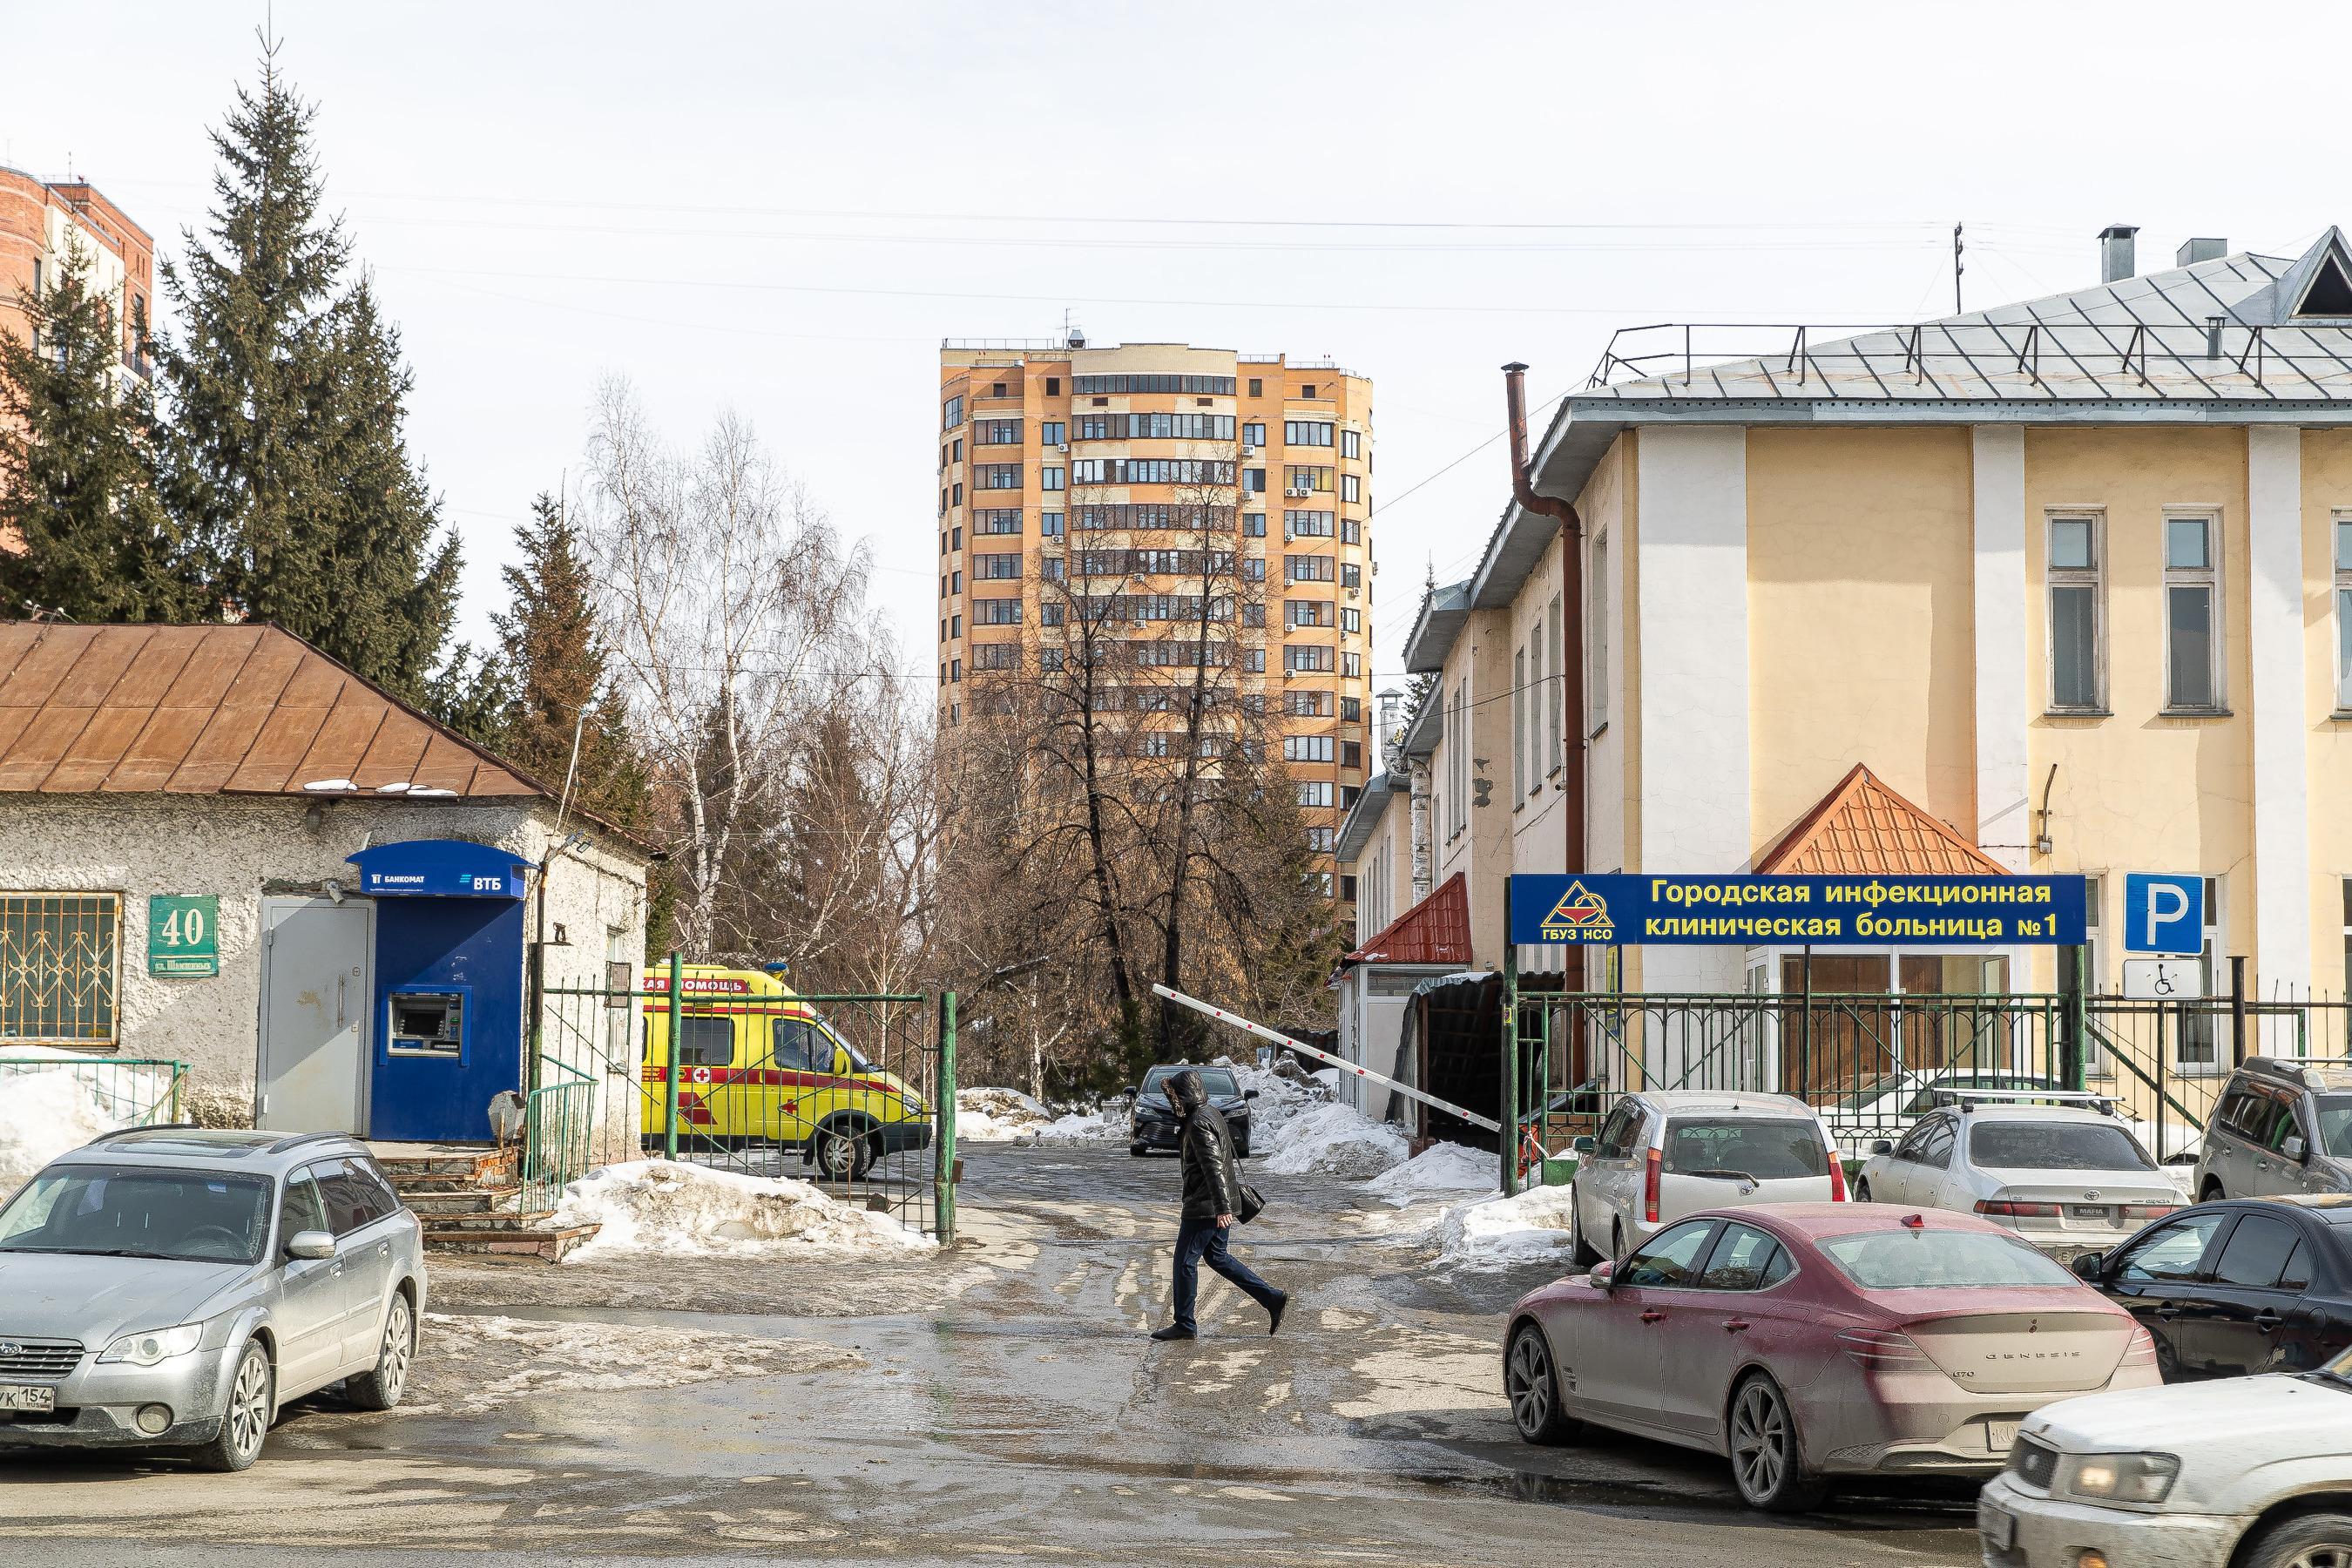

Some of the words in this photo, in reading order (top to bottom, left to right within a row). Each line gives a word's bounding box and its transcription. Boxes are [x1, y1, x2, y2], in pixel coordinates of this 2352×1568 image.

[384, 875, 425, 884] БАНКОМАТ
[473, 877, 502, 890] ВТБ
[1652, 880, 1811, 907] Городская
[1825, 881, 2051, 908] инфекционная
[2146, 882, 2189, 946] P
[161, 908, 204, 948] 40
[1645, 917, 1842, 936] клиническая
[1855, 912, 2003, 940] больница
[2017, 913, 2057, 936] №1
[1542, 929, 1578, 941] ГБУЗ
[1583, 929, 1613, 941] НСО
[681, 980, 742, 992] ОМОЩЬ
[1985, 1351, 2081, 1360] GENESIS
[22, 1388, 51, 1403] 154
